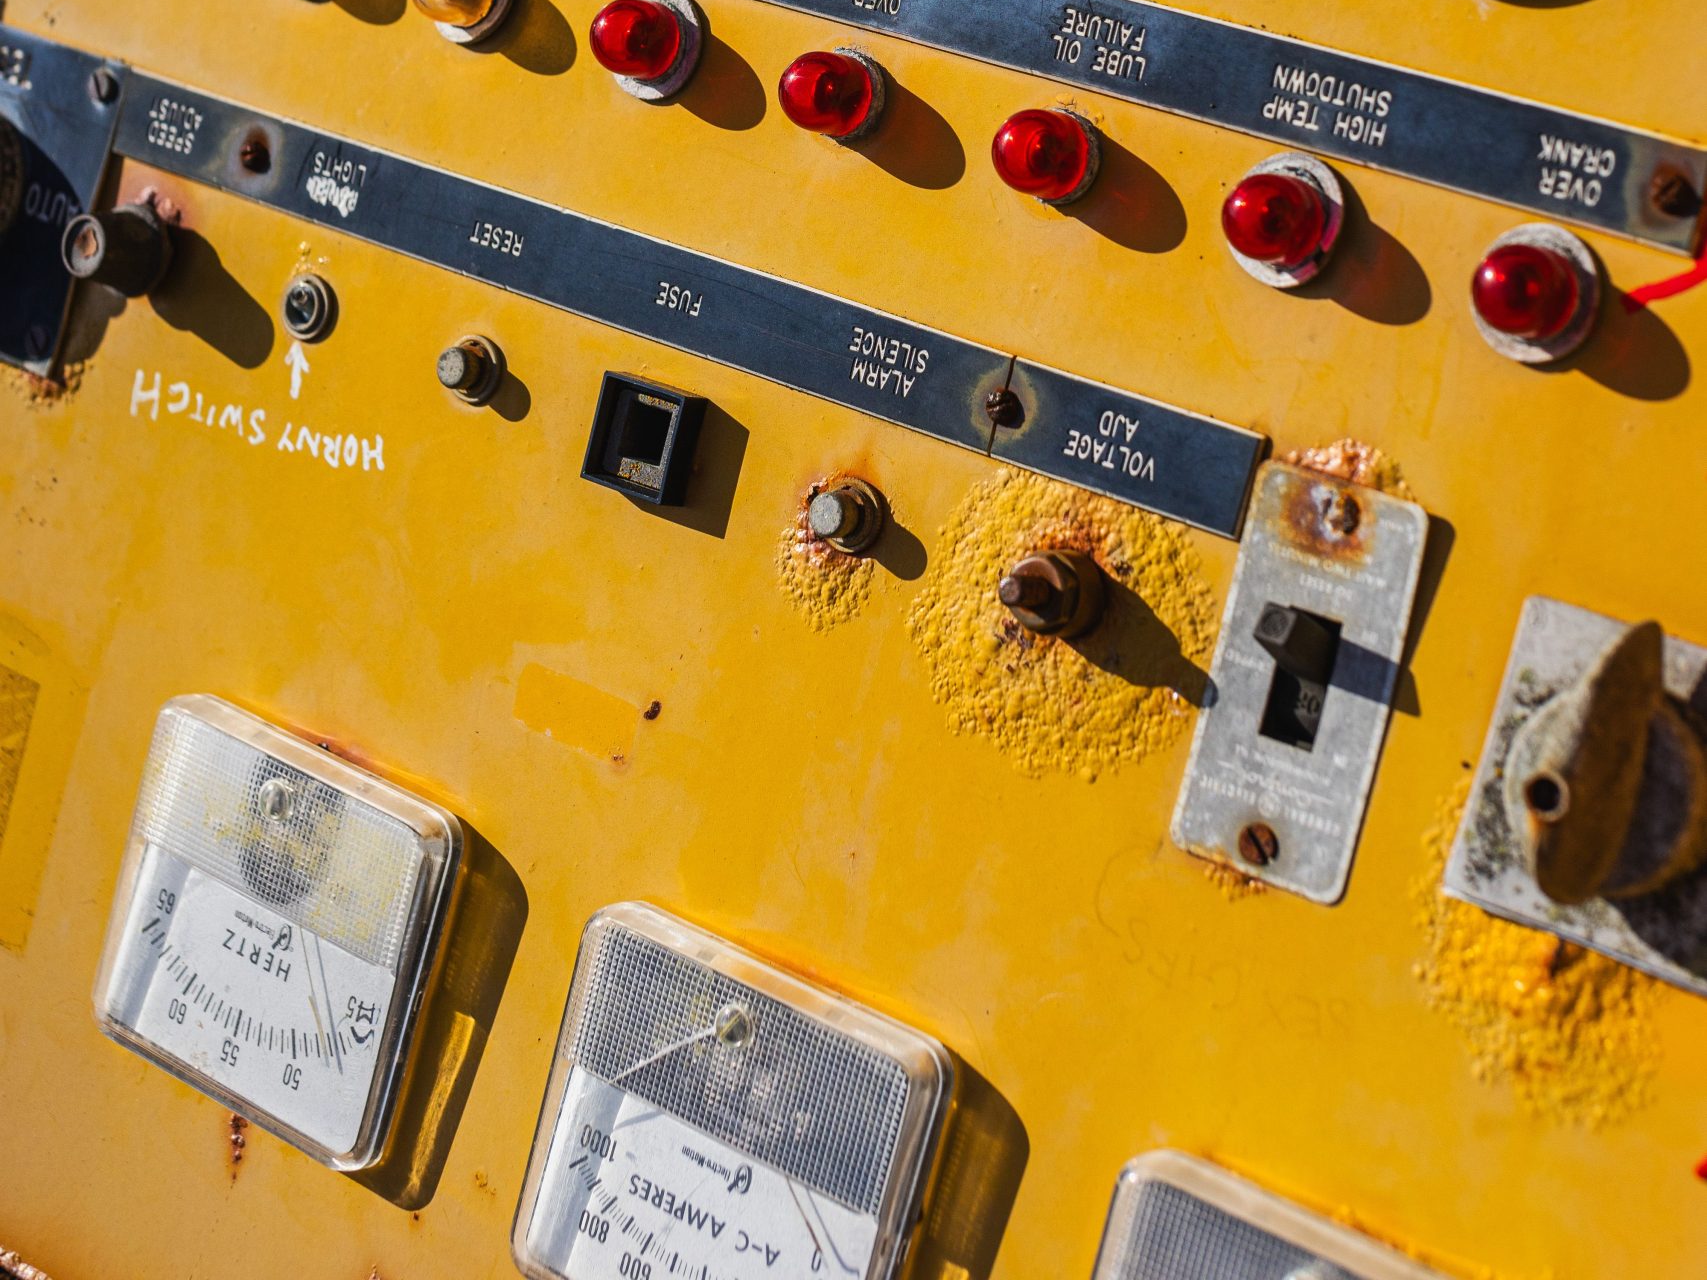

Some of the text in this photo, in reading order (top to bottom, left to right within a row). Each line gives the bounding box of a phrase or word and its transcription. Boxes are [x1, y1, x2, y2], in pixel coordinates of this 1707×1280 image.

[1061, 8, 1146, 52] FAILURE
[1053, 34, 1146, 81] LUBE OIL
[1273, 65, 1393, 117] SHUTDOWN
[149, 97, 203, 131] ADJUST
[1262, 95, 1387, 147] HIGH TEMP
[148, 121, 195, 155] SPEED
[1537, 134, 1616, 177] CRANK
[313, 151, 367, 187] LIGHTS
[1538, 167, 1602, 207] OVER
[470, 222, 524, 257] RESET
[655, 281, 703, 317] FUSE
[848, 327, 930, 374] SILENCE
[850, 358, 916, 398] ALARM
[130, 369, 385, 472] HORNY SWITCH
[1099, 410, 1139, 442] AJD
[1063, 429, 1155, 482] VOLTAGE
[156, 888, 176, 915] 65
[222, 927, 292, 983] HERTZ
[168, 998, 188, 1025] 60
[220, 1039, 240, 1067] 55
[282, 1063, 302, 1091] 50
[580, 1123, 618, 1163] 1000
[578, 1209, 610, 1244] 800
[628, 1173, 781, 1268] A-C AMPERES
[618, 1251, 652, 1280] 600
